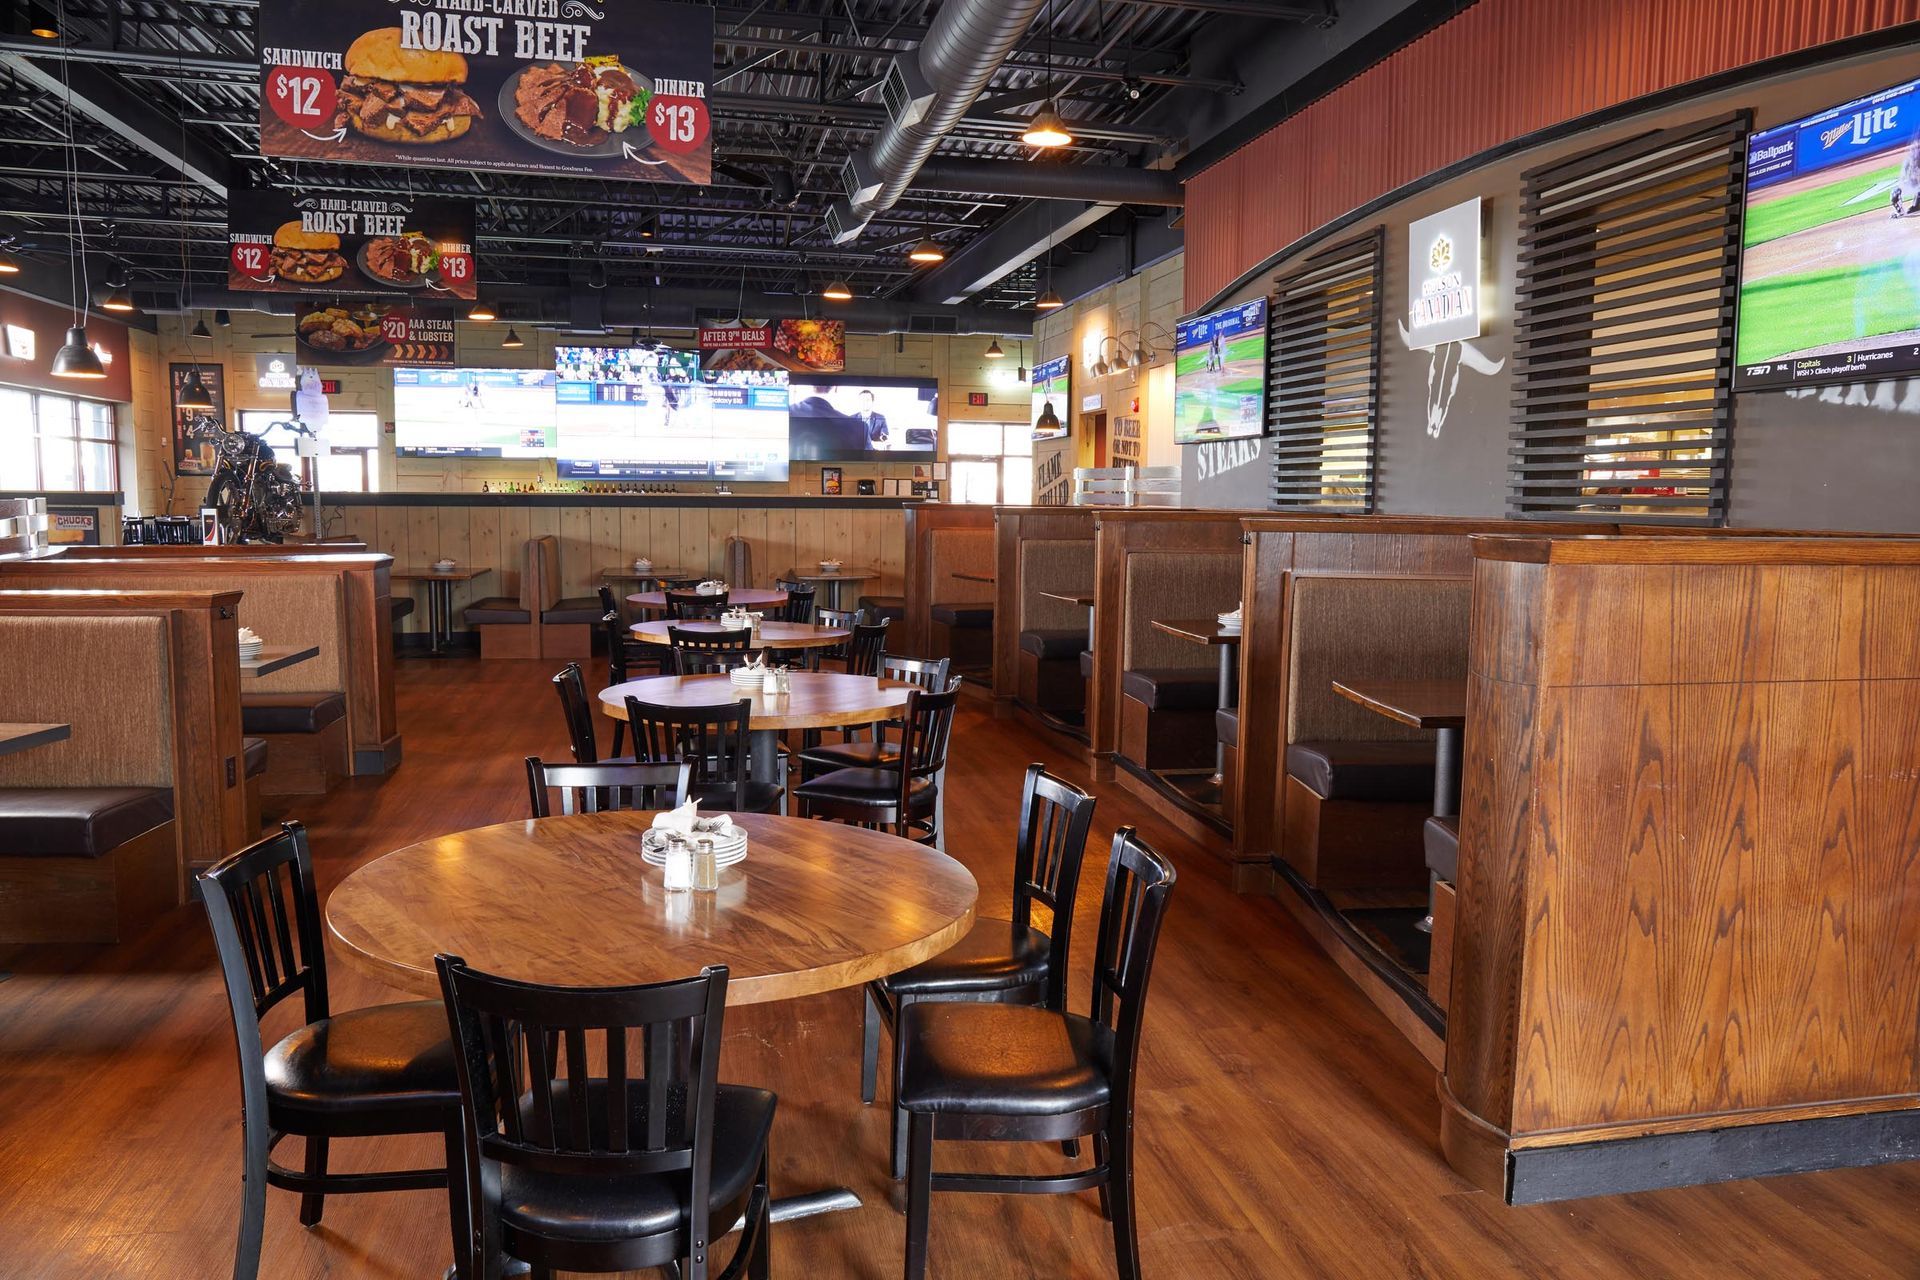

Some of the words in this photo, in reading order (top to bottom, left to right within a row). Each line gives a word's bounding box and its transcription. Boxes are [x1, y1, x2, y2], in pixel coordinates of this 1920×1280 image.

[400, 10, 503, 56] ROAST
[514, 20, 591, 63] BEEF
[263, 47, 343, 70] SANDWICH
[654, 78, 706, 98] DINNER
[1820, 120, 1855, 150] Miller
[1849, 106, 1899, 144] Lite
[1757, 140, 1794, 161] Ballpark
[493, 161, 515, 169] applicable
[320, 198, 388, 213] HAND-CARVED
[301, 211, 358, 235] ROAST
[363, 214, 406, 236] BEEF
[230, 233, 273, 245] SANDWICH
[442, 242, 471, 254] DINNER
[237, 247, 262, 269] $12
[443, 256, 466, 278] $13
[1413, 289, 1471, 325] CANADIAN
[382, 319, 406, 339] $20
[409, 319, 425, 329] AAA
[426, 319, 452, 330] STEAK
[409, 331, 416, 341] &
[418, 331, 454, 342] LOBSTER
[703, 331, 727, 341] AFTER
[742, 330, 765, 341] DEALS
[1857, 351, 1893, 362] Hurricanes
[1913, 347, 1920, 355] 2
[1746, 365, 1771, 376] TSN
[1797, 360, 1821, 369] Capitals
[1847, 355, 1852, 363] 3
[1796, 369, 1810, 377] WSH
[1831, 364, 1850, 374] playoff
[1850, 363, 1867, 371] berth
[1114, 417, 1123, 437] TO
[1124, 419, 1140, 438] BEER
[1113, 439, 1121, 454] OR
[1121, 441, 1132, 456] NOT
[1133, 442, 1140, 457] TO
[1038, 451, 1062, 490] FLAME
